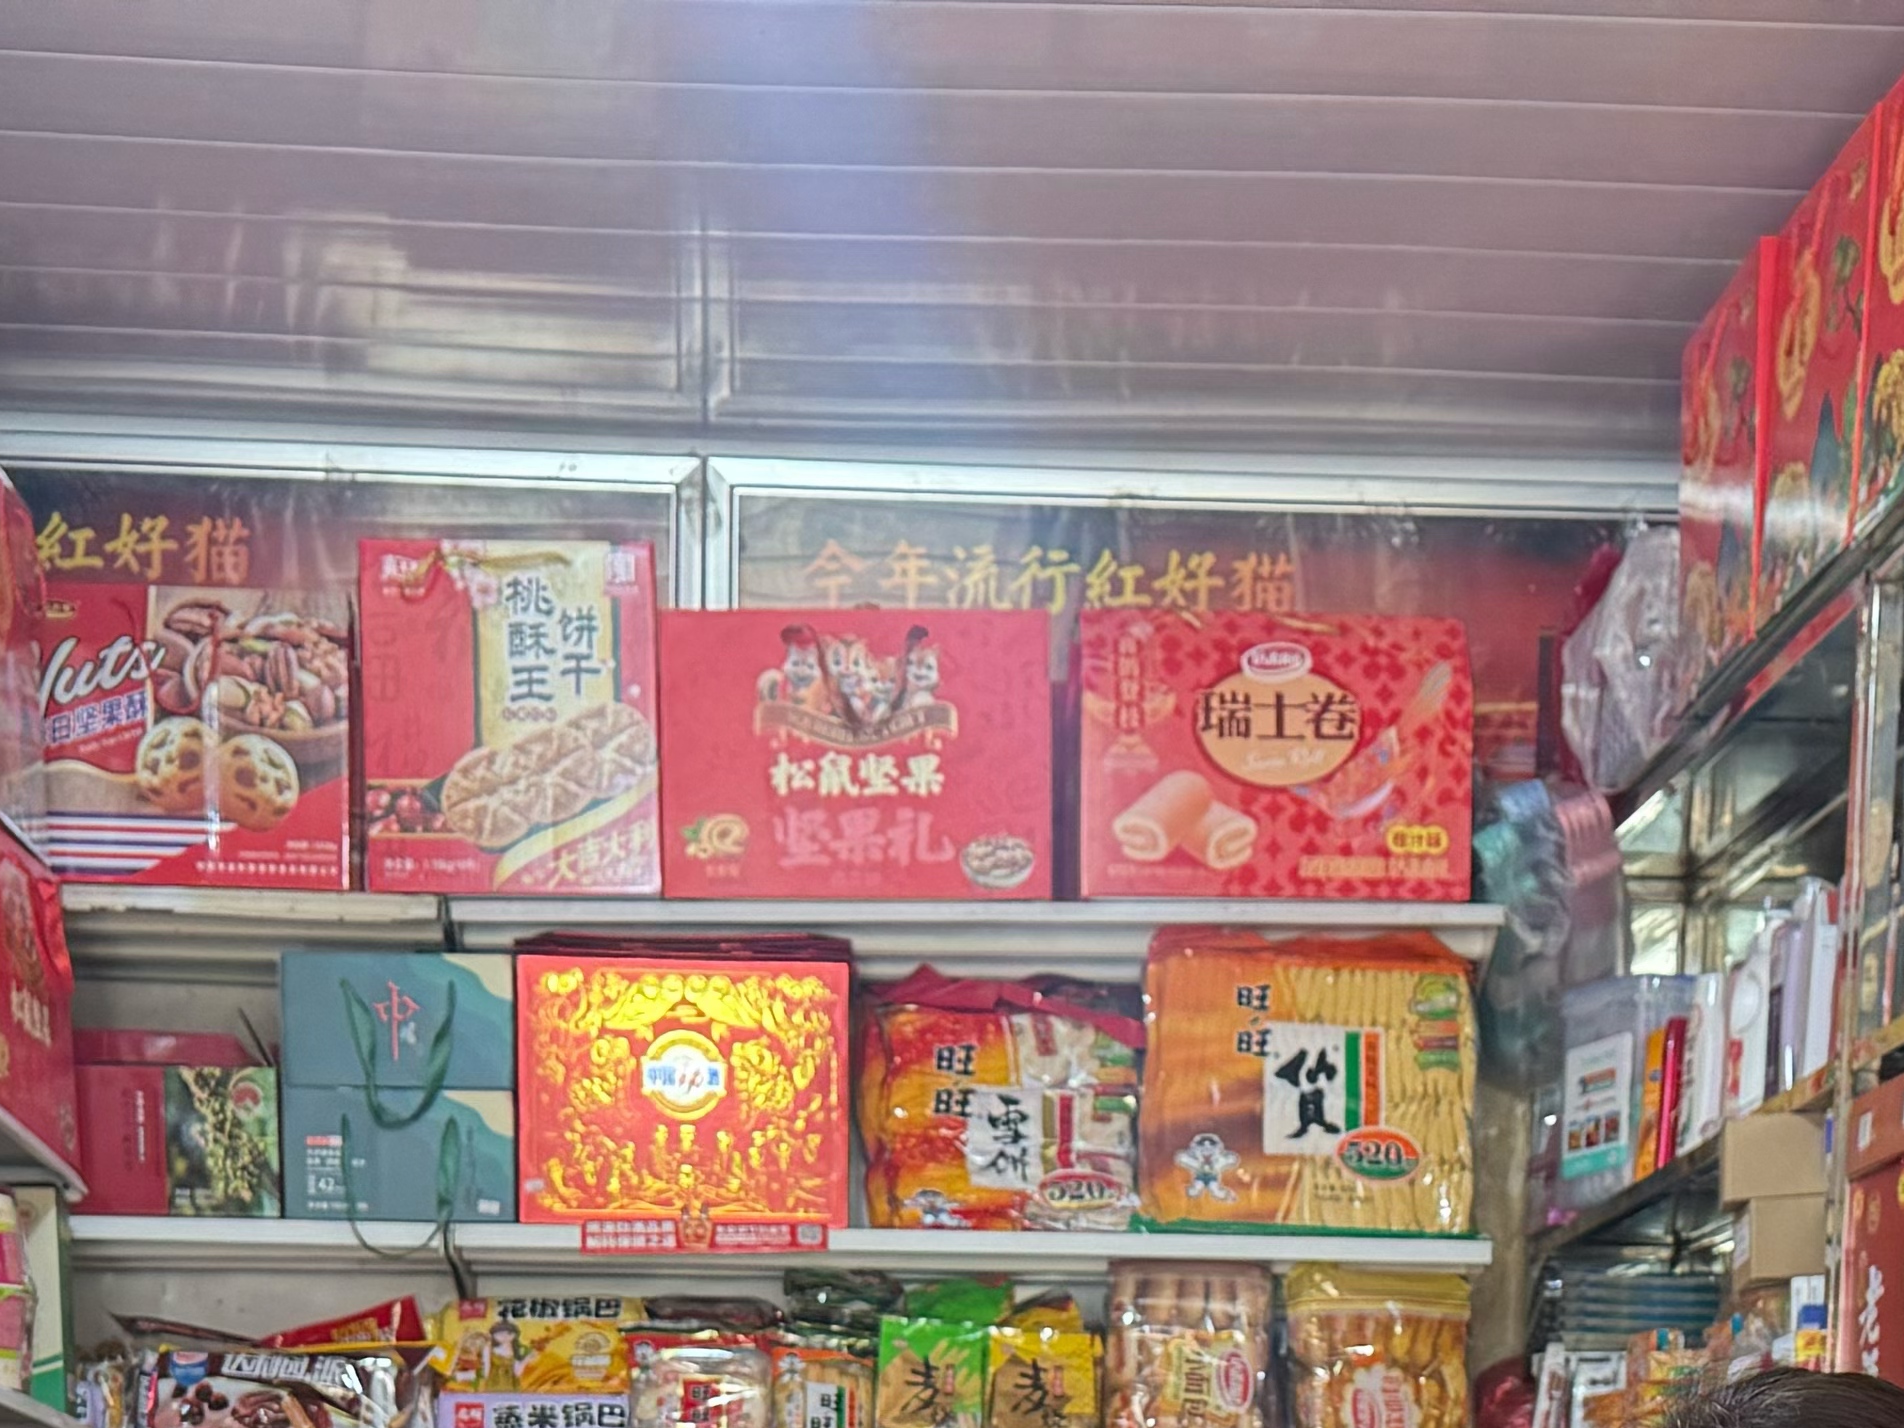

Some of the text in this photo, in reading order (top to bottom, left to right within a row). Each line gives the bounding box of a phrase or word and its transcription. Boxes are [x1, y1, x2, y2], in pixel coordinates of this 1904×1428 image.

[503, 574, 556, 701] 桃酥王
[559, 603, 601, 695] 饼干
[1195, 690, 1359, 743] 瑞士卷
[770, 752, 944, 797] 松鼠坚果
[1339, 1139, 1403, 1170] 520
